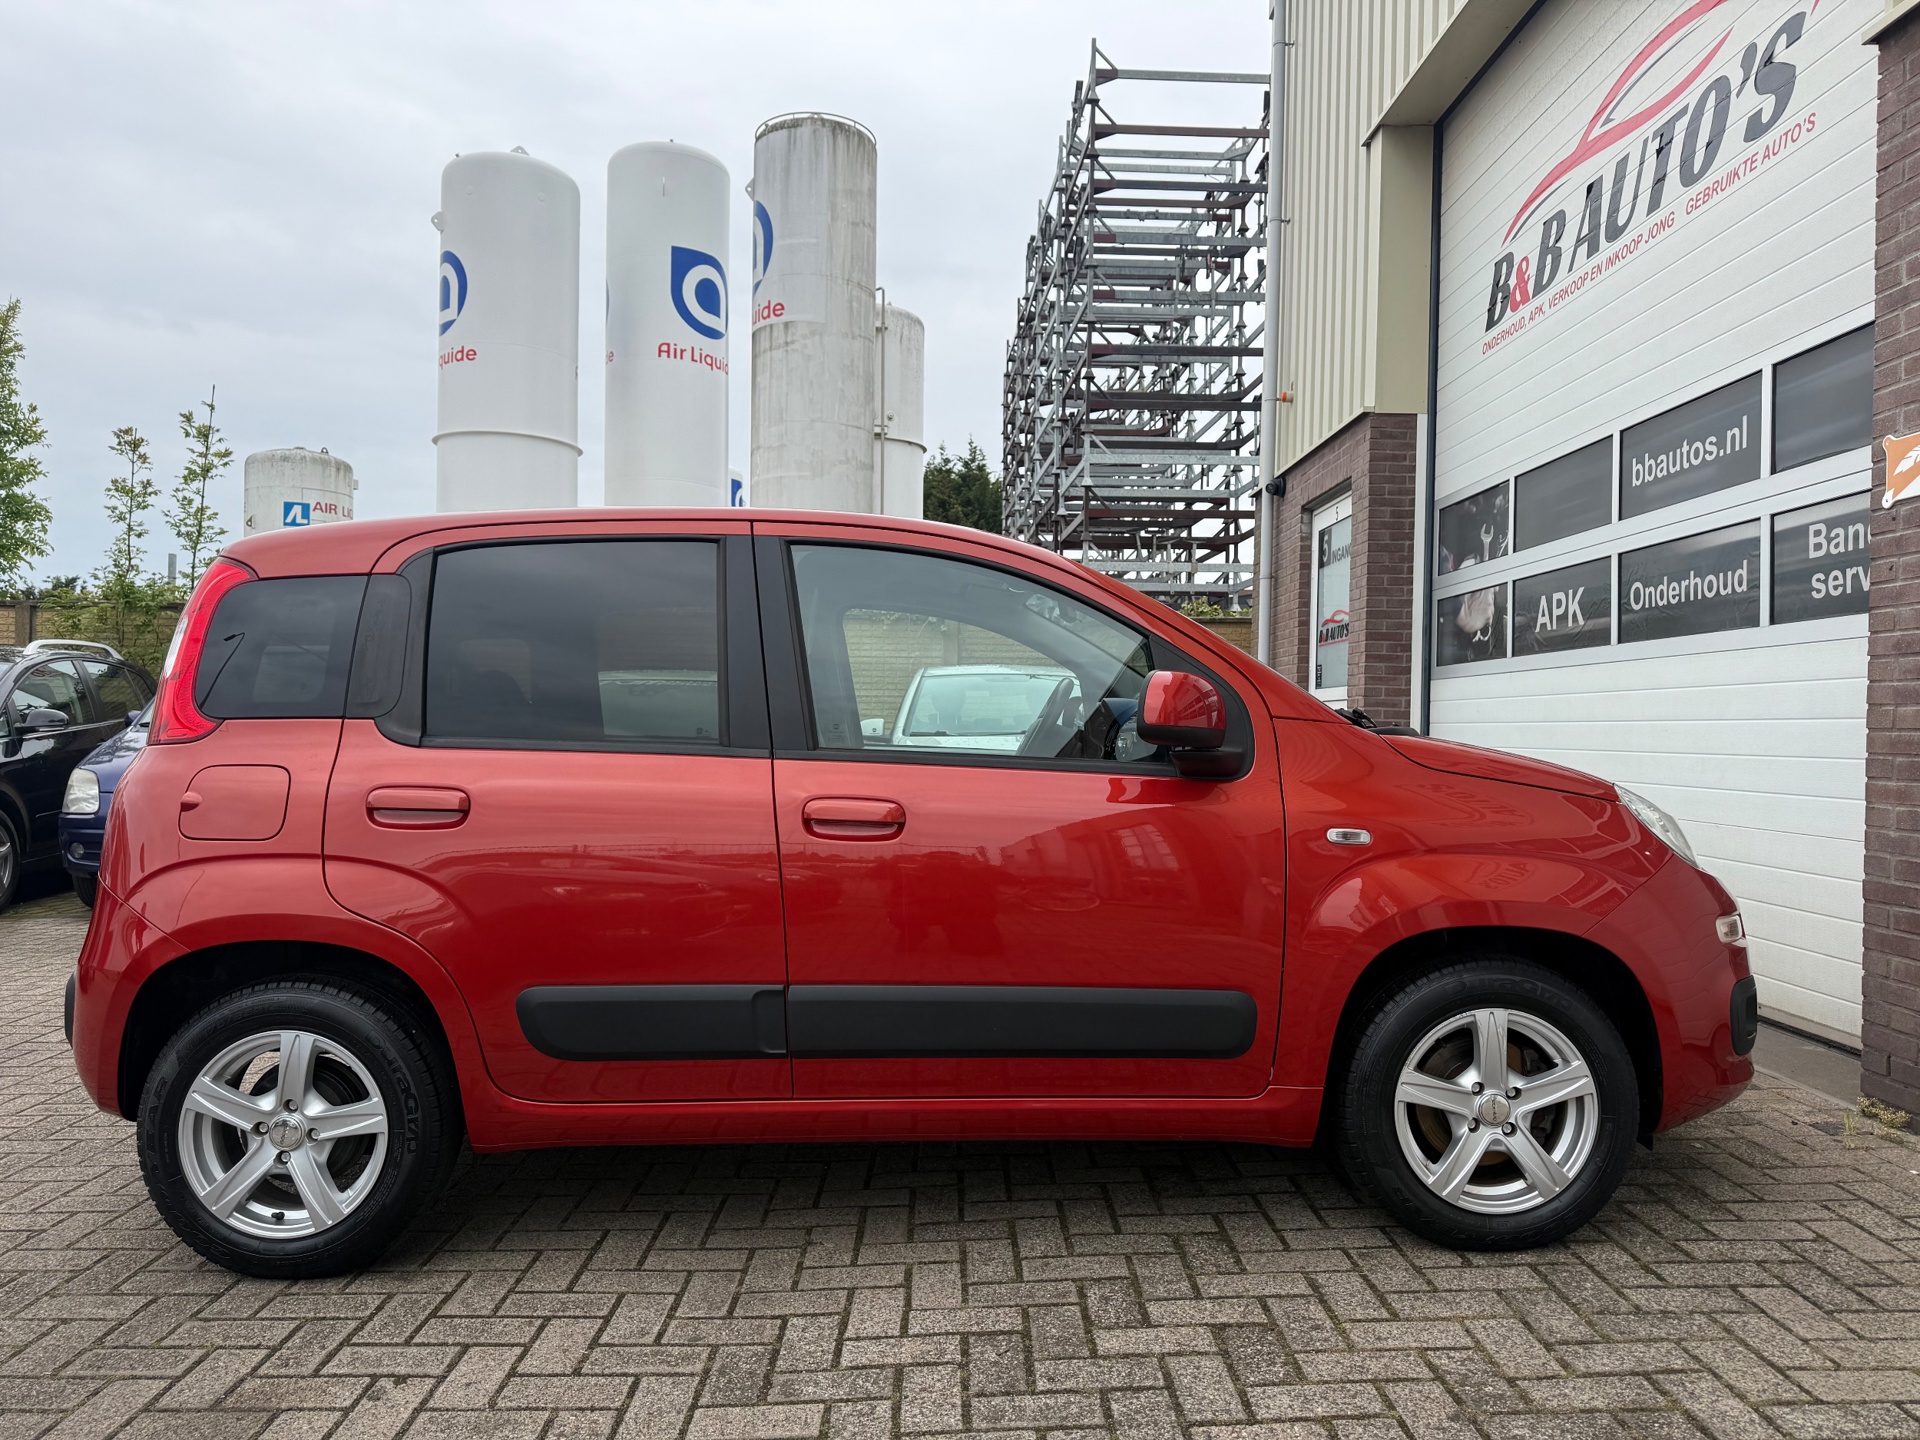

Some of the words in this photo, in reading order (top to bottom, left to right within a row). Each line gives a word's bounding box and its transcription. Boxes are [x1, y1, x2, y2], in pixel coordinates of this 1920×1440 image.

[1485, 209, 1566, 333] B&B
[1567, 11, 1806, 274] AUTO'S
[1482, 316, 1526, 355] ONDERHOUD,
[1528, 302, 1546, 325] APK,
[1548, 271, 1588, 309] VERKOOP
[1590, 262, 1603, 282] EN
[1605, 233, 1643, 272] INKOOP
[1645, 211, 1675, 244] JONG
[1685, 151, 1759, 215] GEBRUIKTE
[1761, 112, 1817, 165] AUTO'S
[658, 342, 686, 360] Air
[1631, 416, 1748, 487] bbautos.nl
[312, 501, 338, 515] AIR
[1335, 506, 1339, 521] 5
[1322, 534, 1329, 563] 5
[1809, 522, 1871, 559] Ban
[1630, 560, 1748, 611] Onderhoud
[1535, 586, 1585, 632] APK
